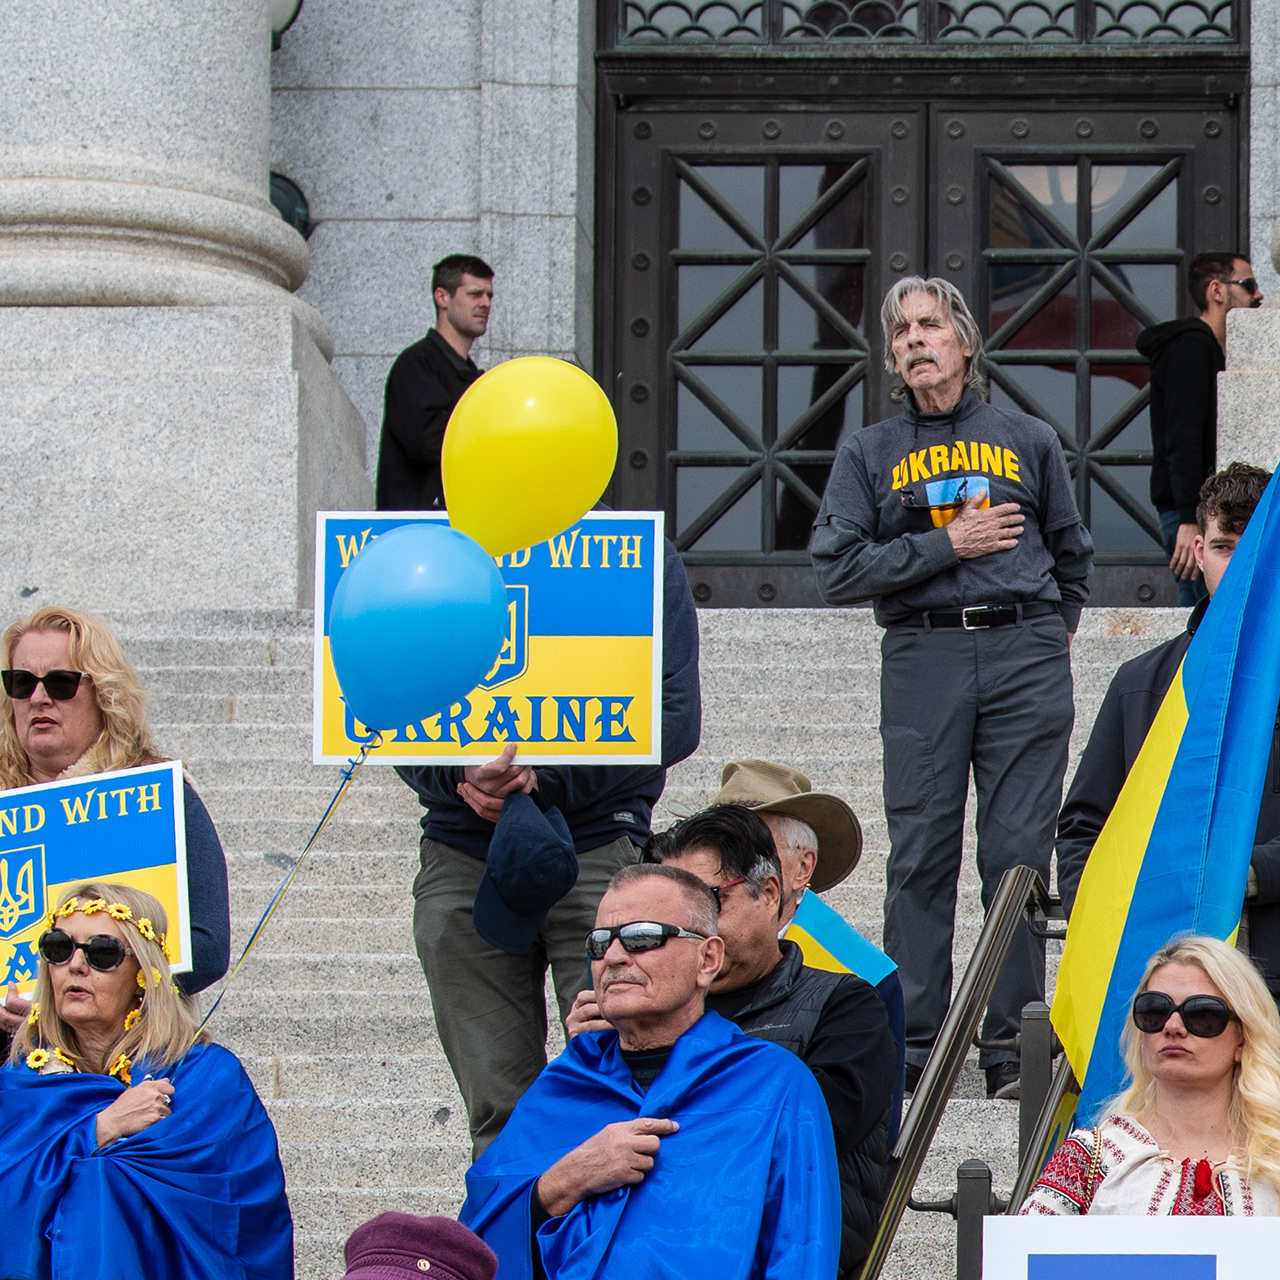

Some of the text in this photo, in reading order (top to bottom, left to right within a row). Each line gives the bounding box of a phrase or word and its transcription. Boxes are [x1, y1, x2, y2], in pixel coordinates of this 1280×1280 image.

[891, 440, 1021, 490] UKRAINE
[547, 527, 644, 568] WITH
[60, 783, 162, 825] WITH
